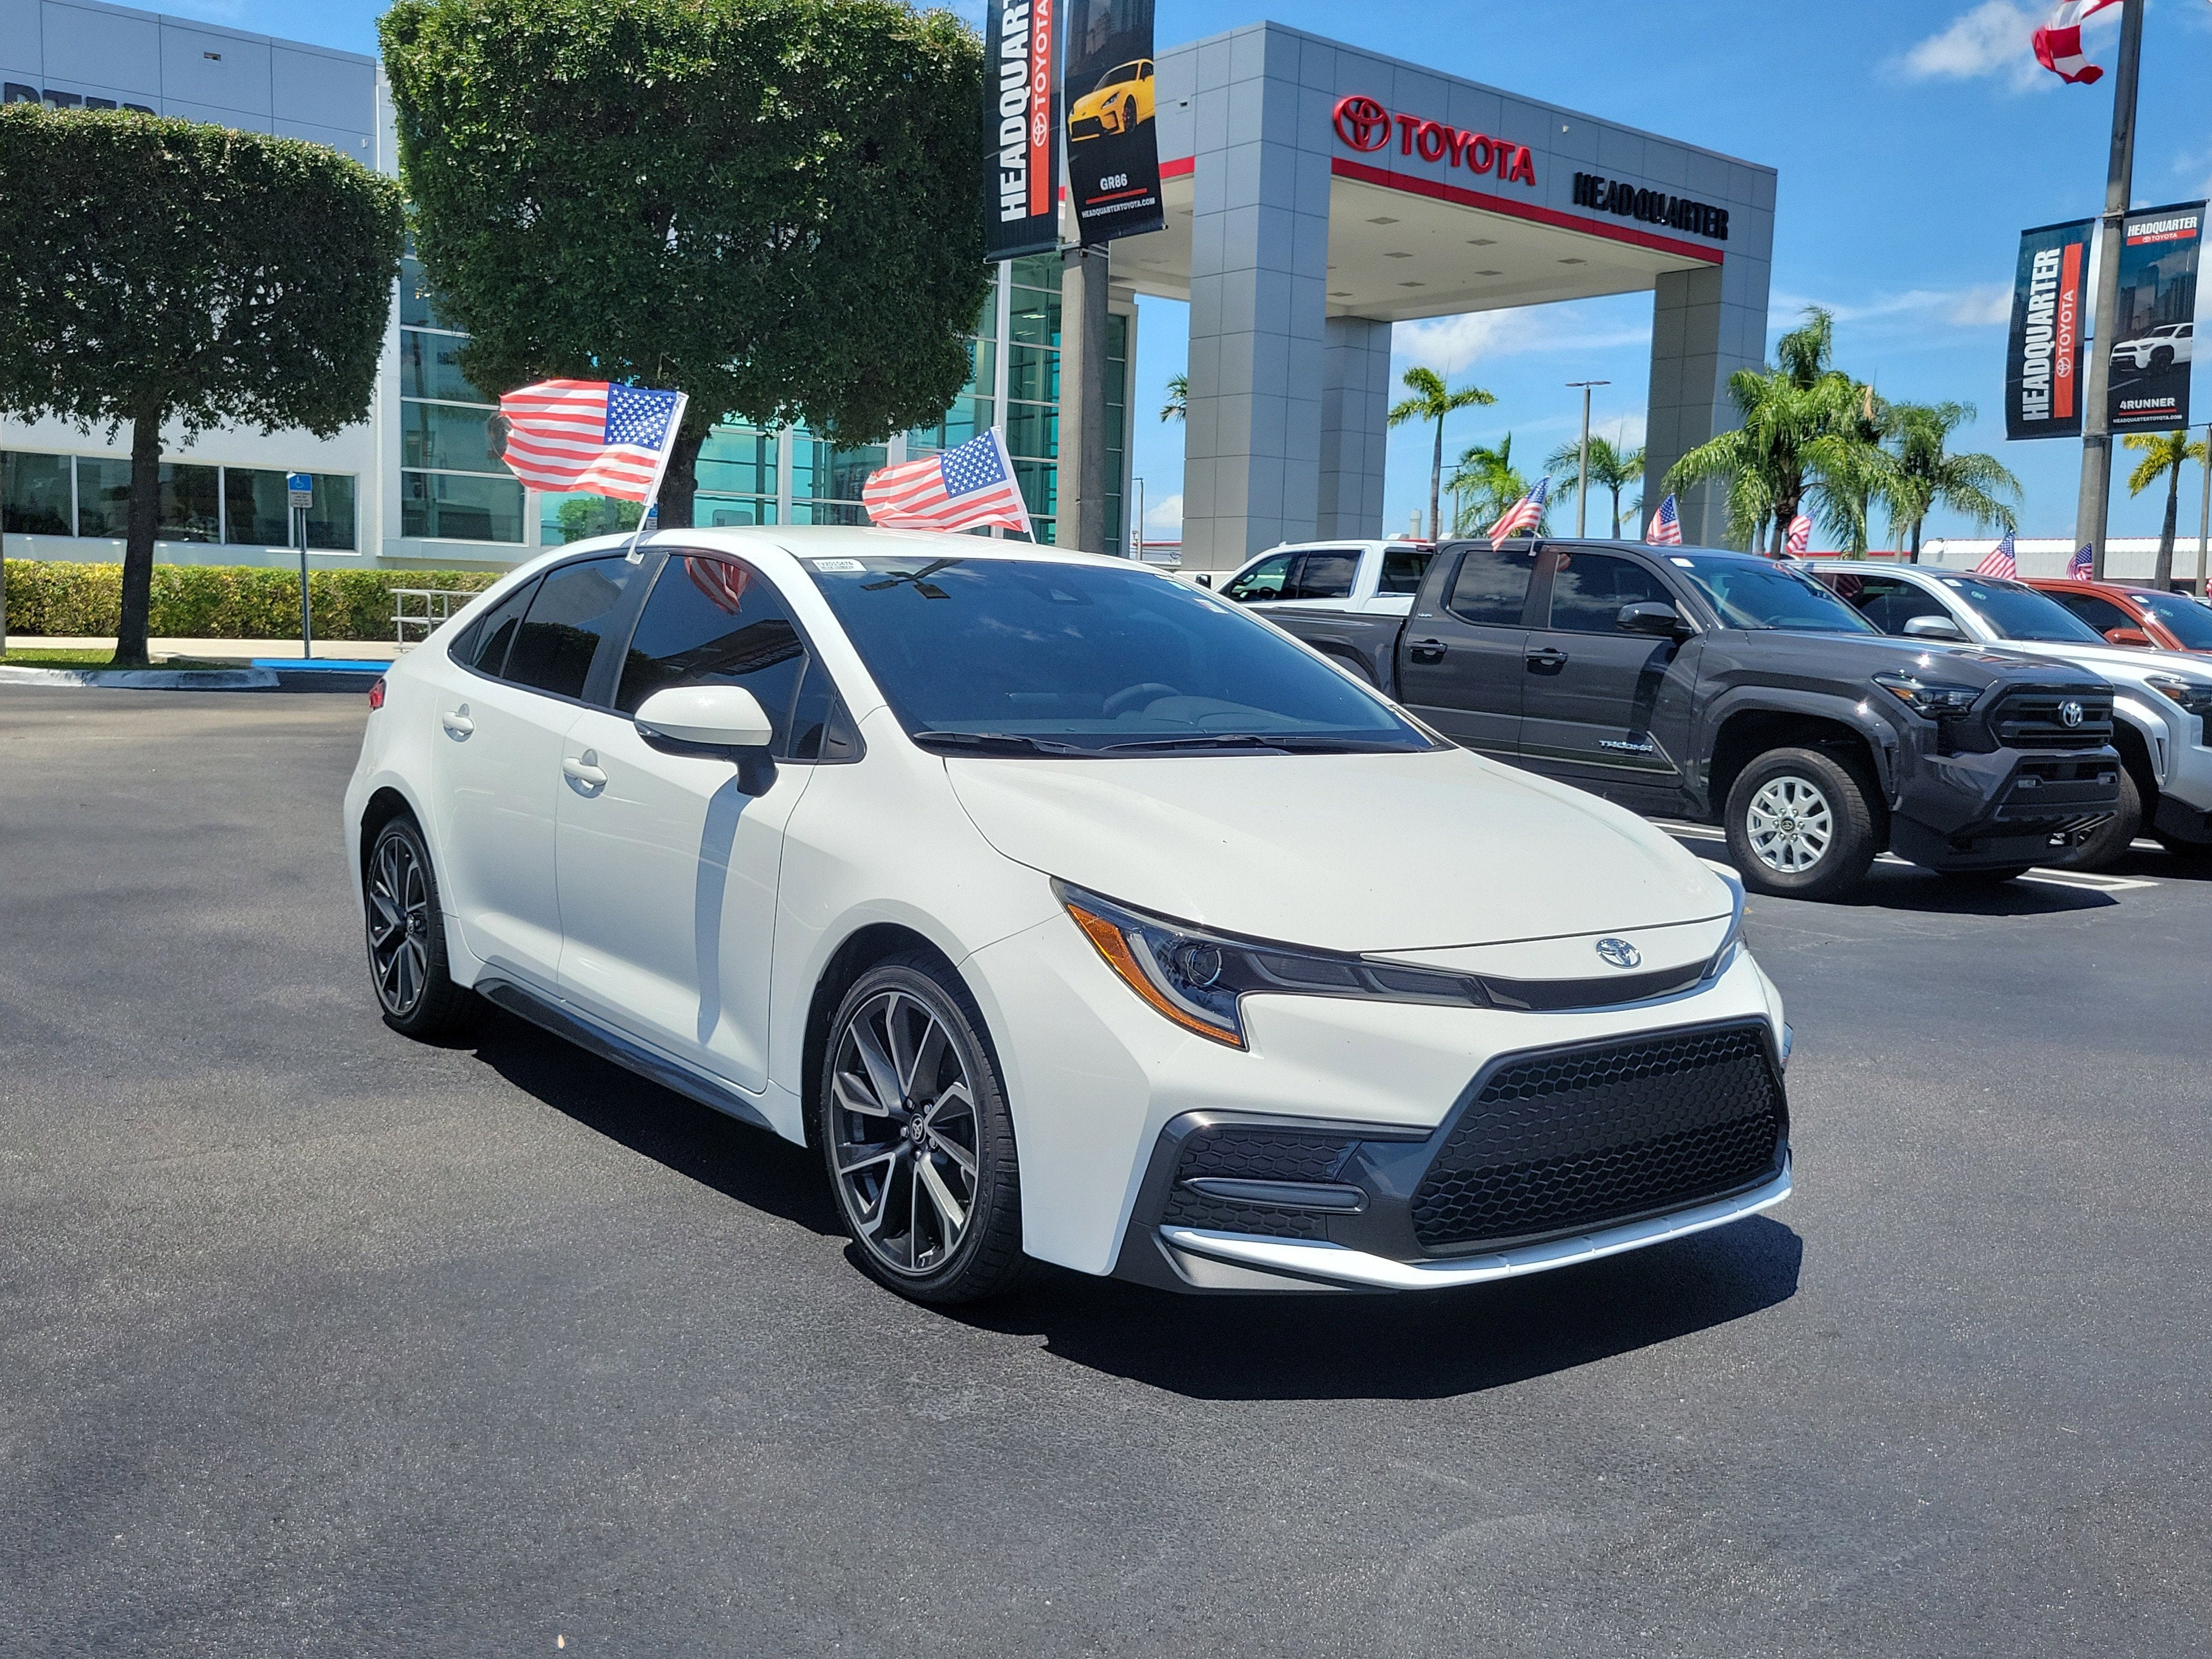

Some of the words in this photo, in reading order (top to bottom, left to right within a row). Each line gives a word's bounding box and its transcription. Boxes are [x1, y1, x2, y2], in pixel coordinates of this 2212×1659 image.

[1034, 0, 1049, 110] TOYOTA
[1395, 114, 1536, 186] TOYOTA
[1100, 173, 1127, 190] GR86
[1081, 196, 1155, 218] HEADQUARTERTOYOTA.COM
[1573, 172, 1729, 240] HEADQUARTER
[2128, 217, 2197, 236] HEADQUARTER
[2152, 233, 2177, 241] TOYOTA
[2057, 289, 2074, 356] TOYOTA
[2022, 247, 2061, 421] HEADQUARTER
[2119, 397, 2175, 410] 4RUNNER
[2113, 415, 2182, 424] HEADQUARTERTOYOTA.COM
